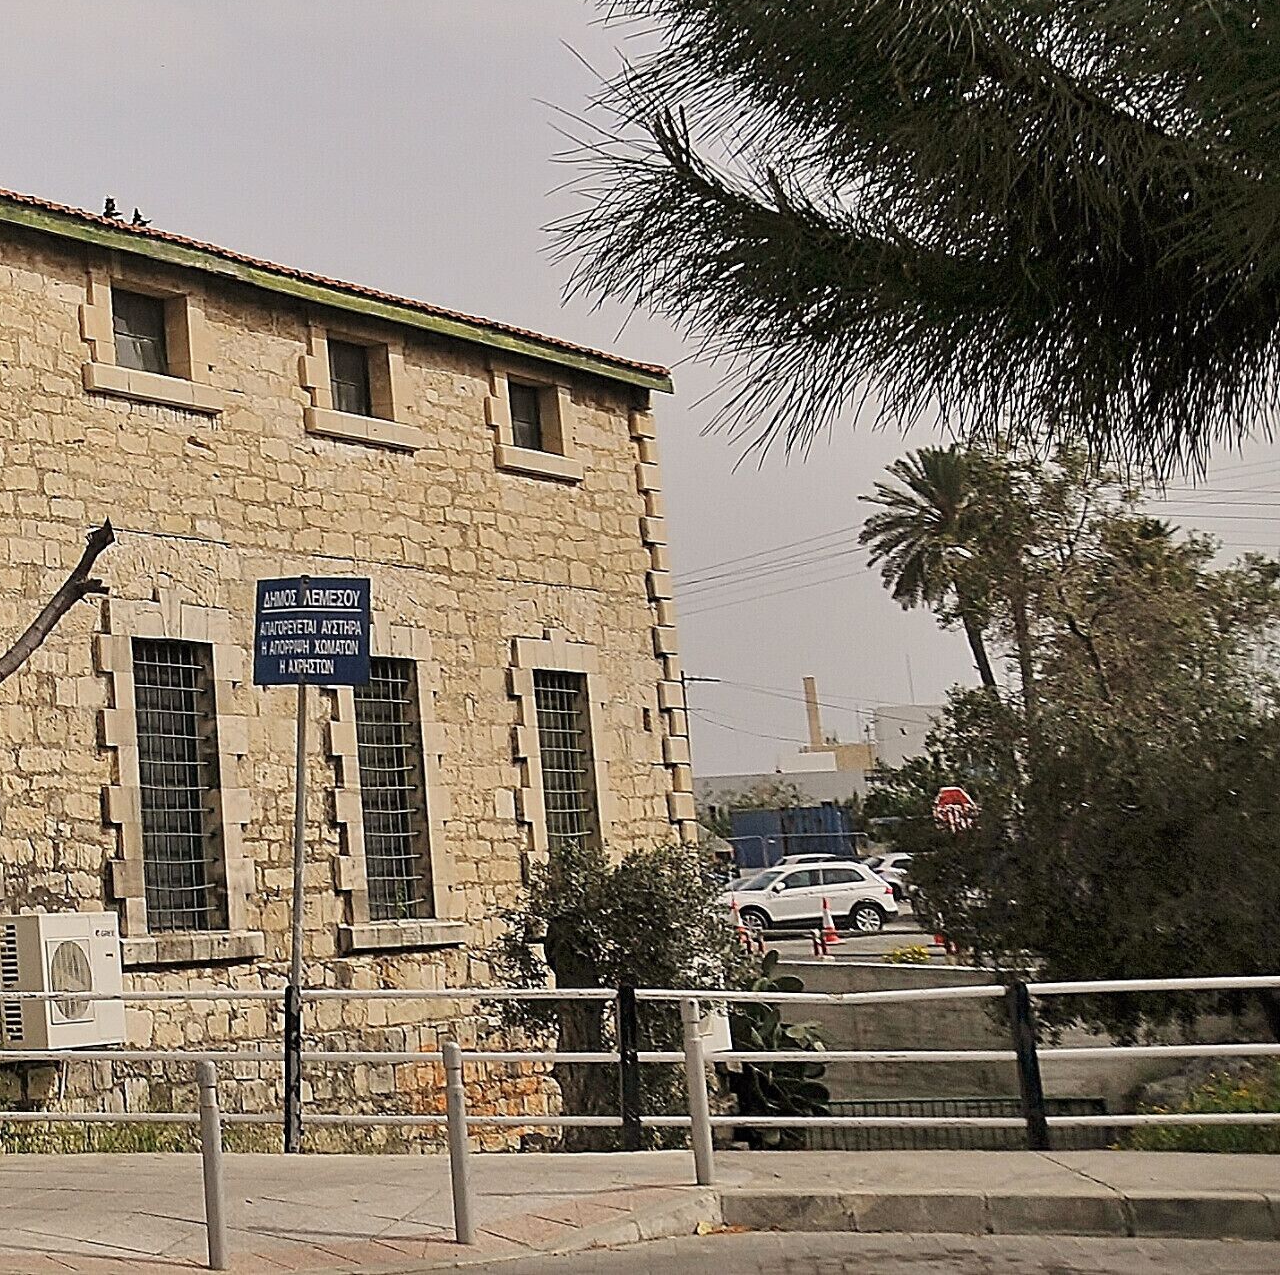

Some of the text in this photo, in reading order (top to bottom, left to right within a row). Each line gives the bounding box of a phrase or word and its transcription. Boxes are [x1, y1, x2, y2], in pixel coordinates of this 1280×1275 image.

[263, 589, 361, 608] ΔΗΜΟΣ ΛΕΜΕΣΟΥ
[260, 619, 362, 636] ΑΠΑΓΟΡΕΥΕΤΑΙ ΑΥΣΤΗΡΑ
[261, 641, 268, 656] Η
[314, 639, 359, 655] ΧΩΜΑΤΩΝ
[279, 659, 334, 674] Η ΑΧΡΗΣΤΩΝ
